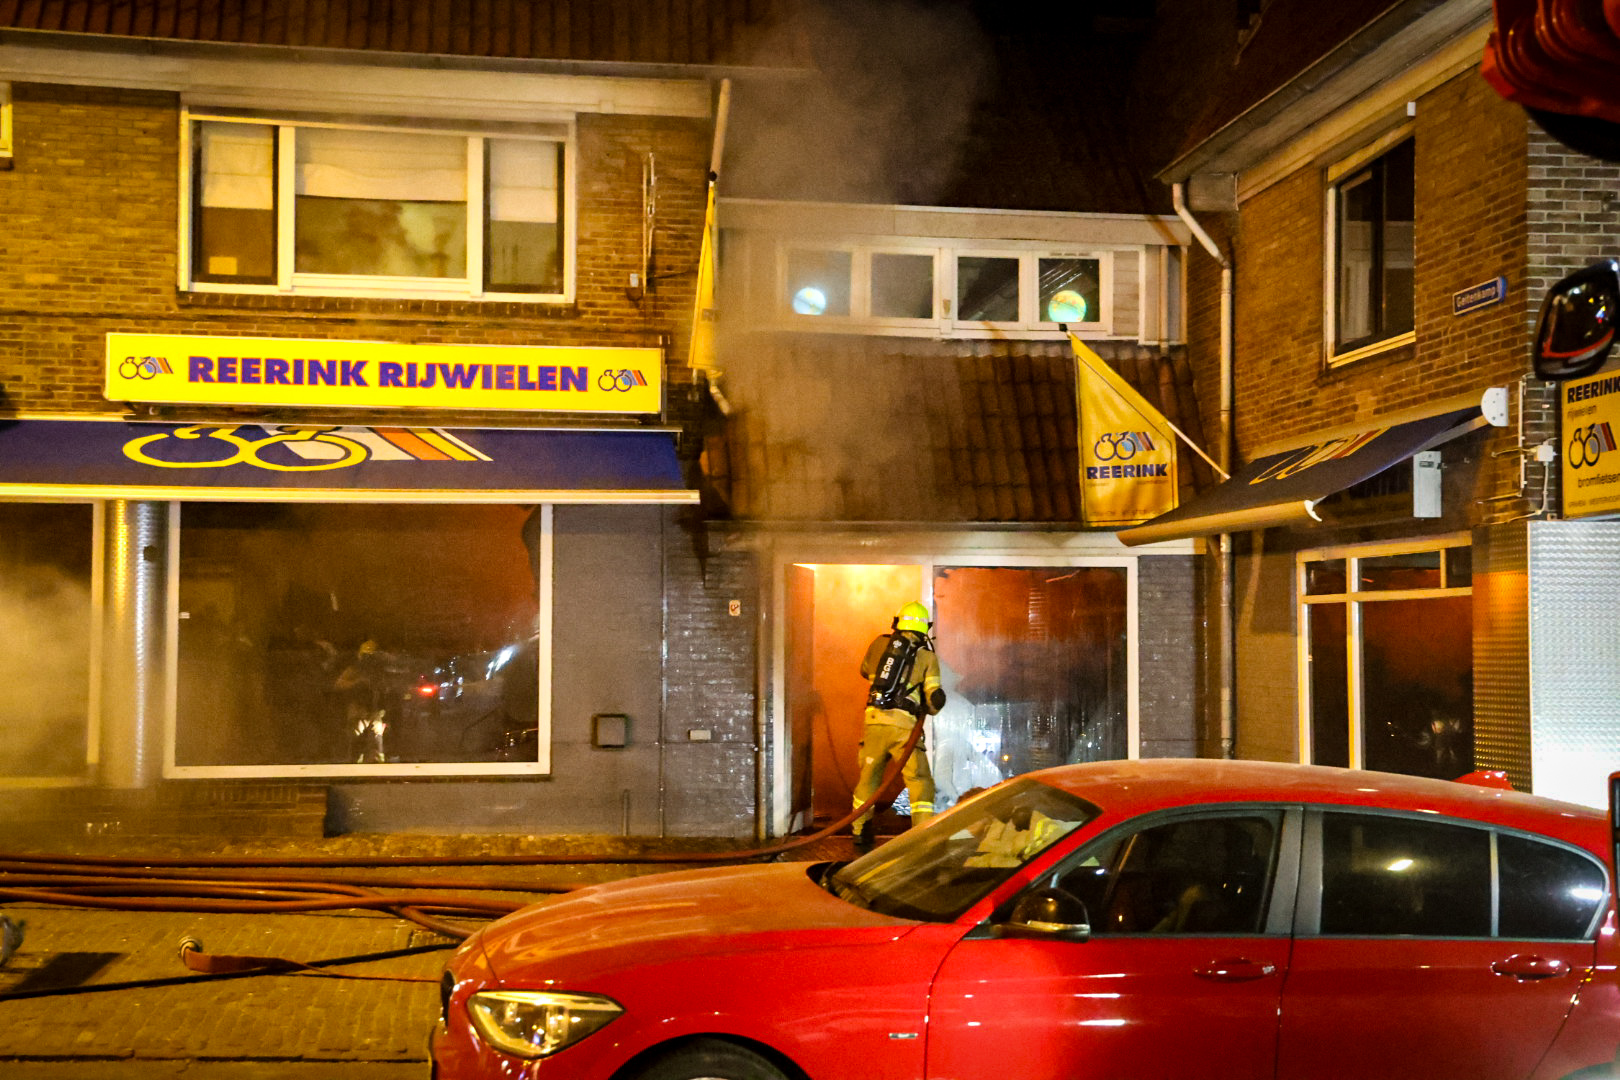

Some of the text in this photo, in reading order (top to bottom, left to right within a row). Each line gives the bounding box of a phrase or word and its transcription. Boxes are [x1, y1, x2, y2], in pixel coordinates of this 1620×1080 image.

[188, 355, 589, 392] REERINK RIJWIELEN
[1567, 376, 1620, 404] REERINK
[1086, 464, 1168, 479] REERINK
[880, 657, 894, 679] BGM
